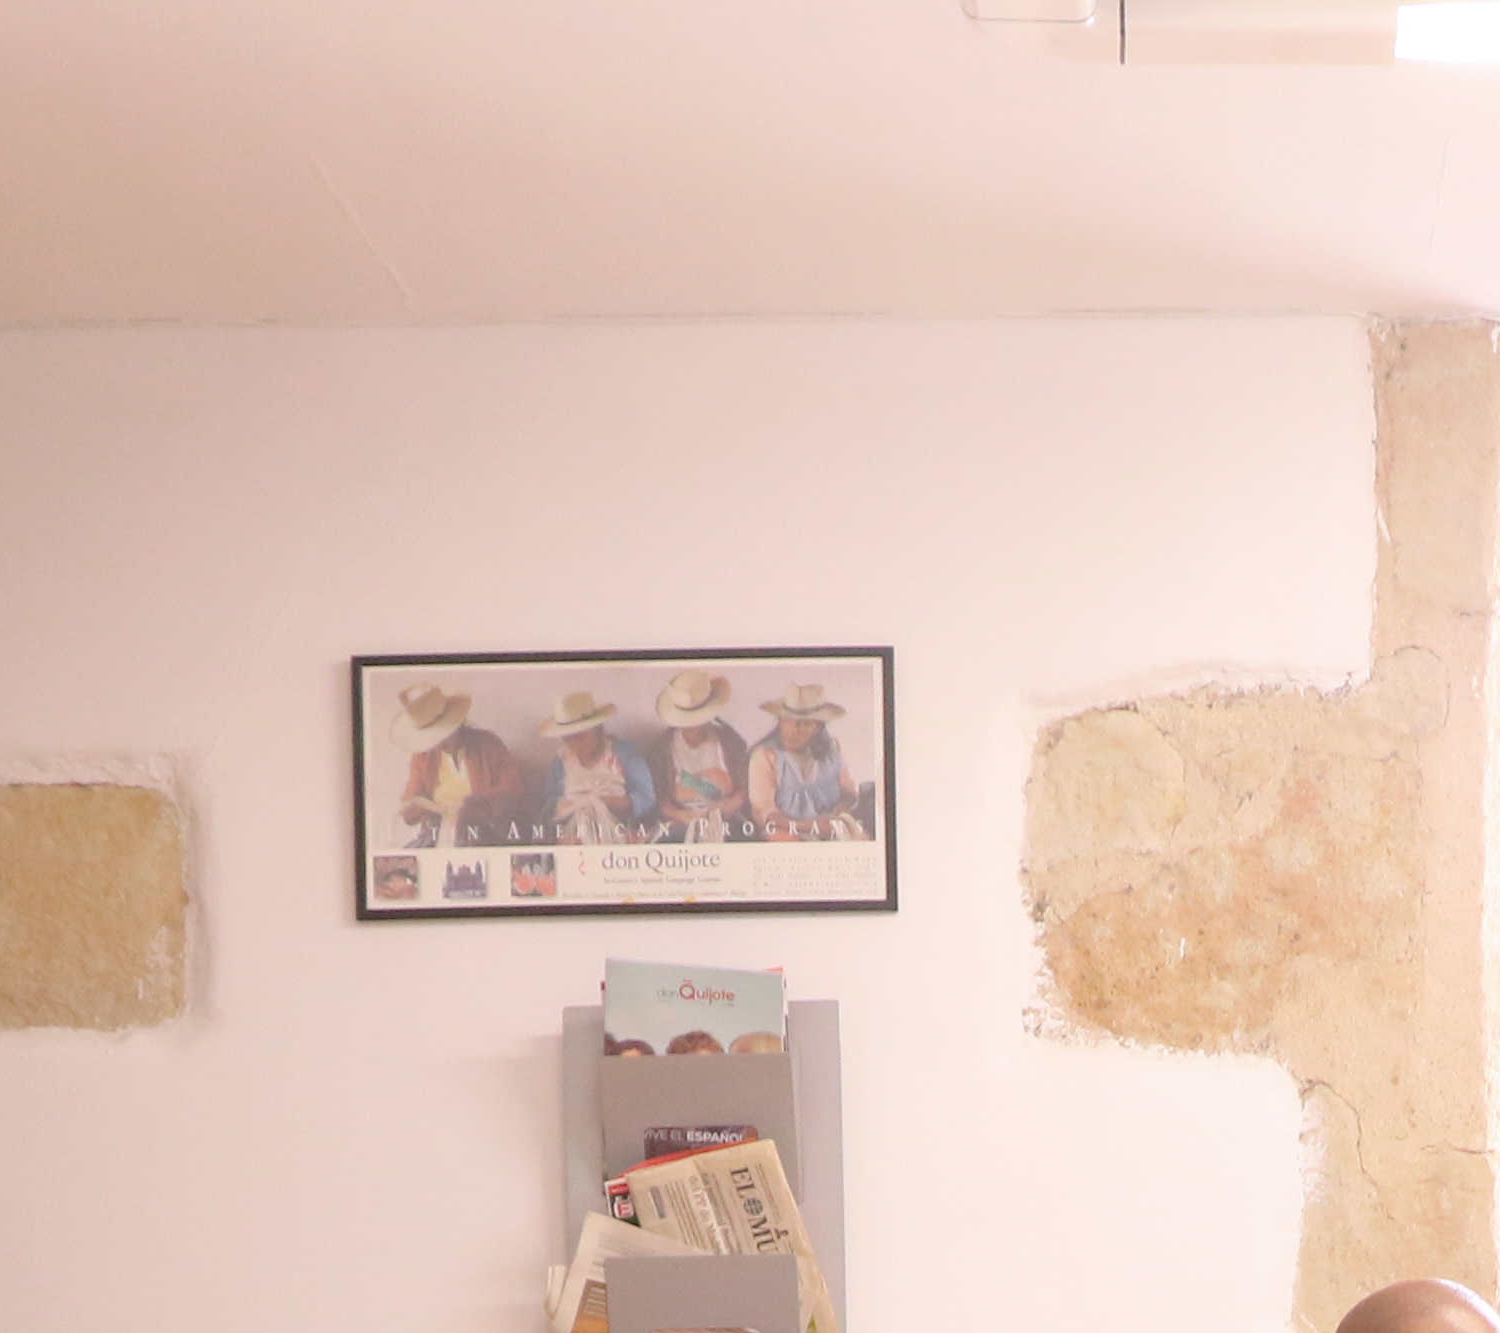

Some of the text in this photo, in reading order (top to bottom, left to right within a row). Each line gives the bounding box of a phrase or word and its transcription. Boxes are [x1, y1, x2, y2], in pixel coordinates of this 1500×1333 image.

[506, 821, 671, 840] AMERICAN
[698, 818, 864, 837] PROGRAMS
[601, 849, 721, 873] don Quijote
[678, 981, 736, 1005] Quijote
[729, 1165, 757, 1200] EL
